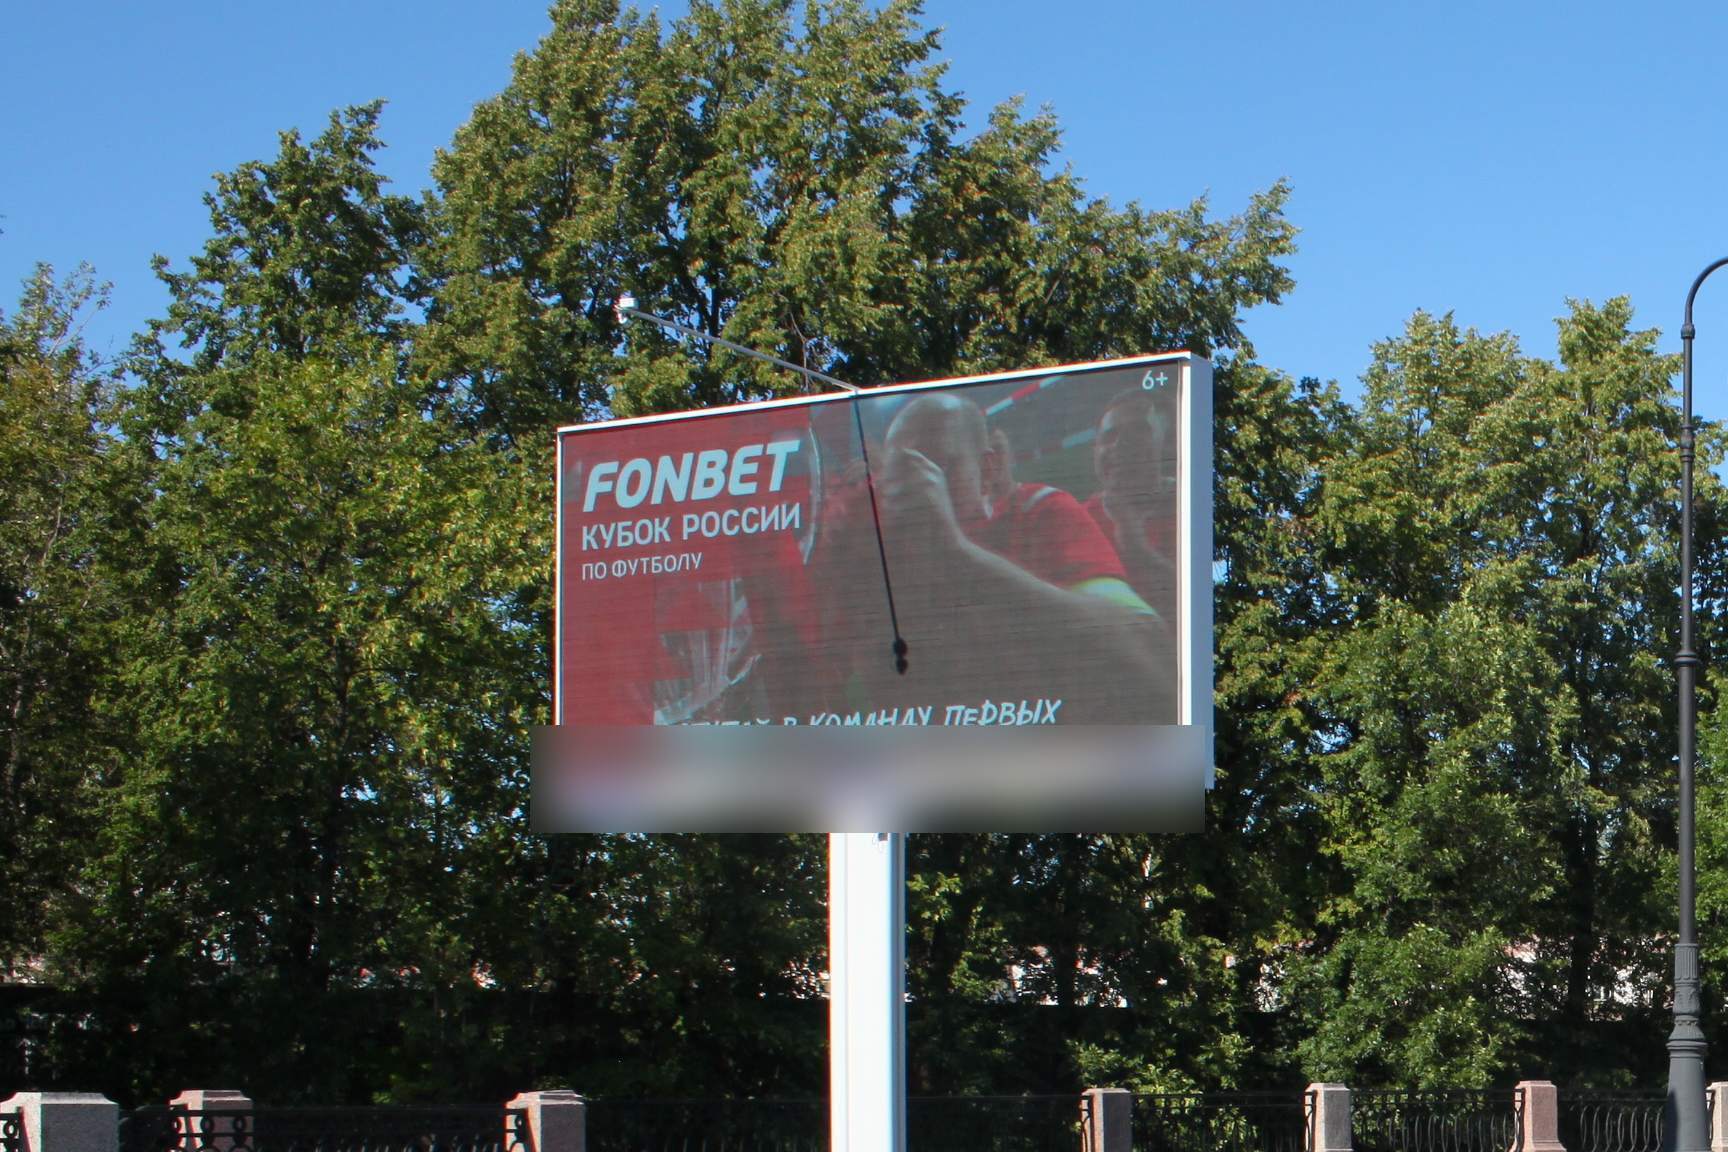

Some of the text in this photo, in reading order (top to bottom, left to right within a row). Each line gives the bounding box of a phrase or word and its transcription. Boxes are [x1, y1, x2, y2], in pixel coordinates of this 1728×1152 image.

[1142, 370, 1169, 390] 6+
[582, 439, 800, 513] FONBET
[581, 502, 800, 551] КУБОК РОССИИ
[581, 552, 702, 581] ПО ФУТБОЛУ
